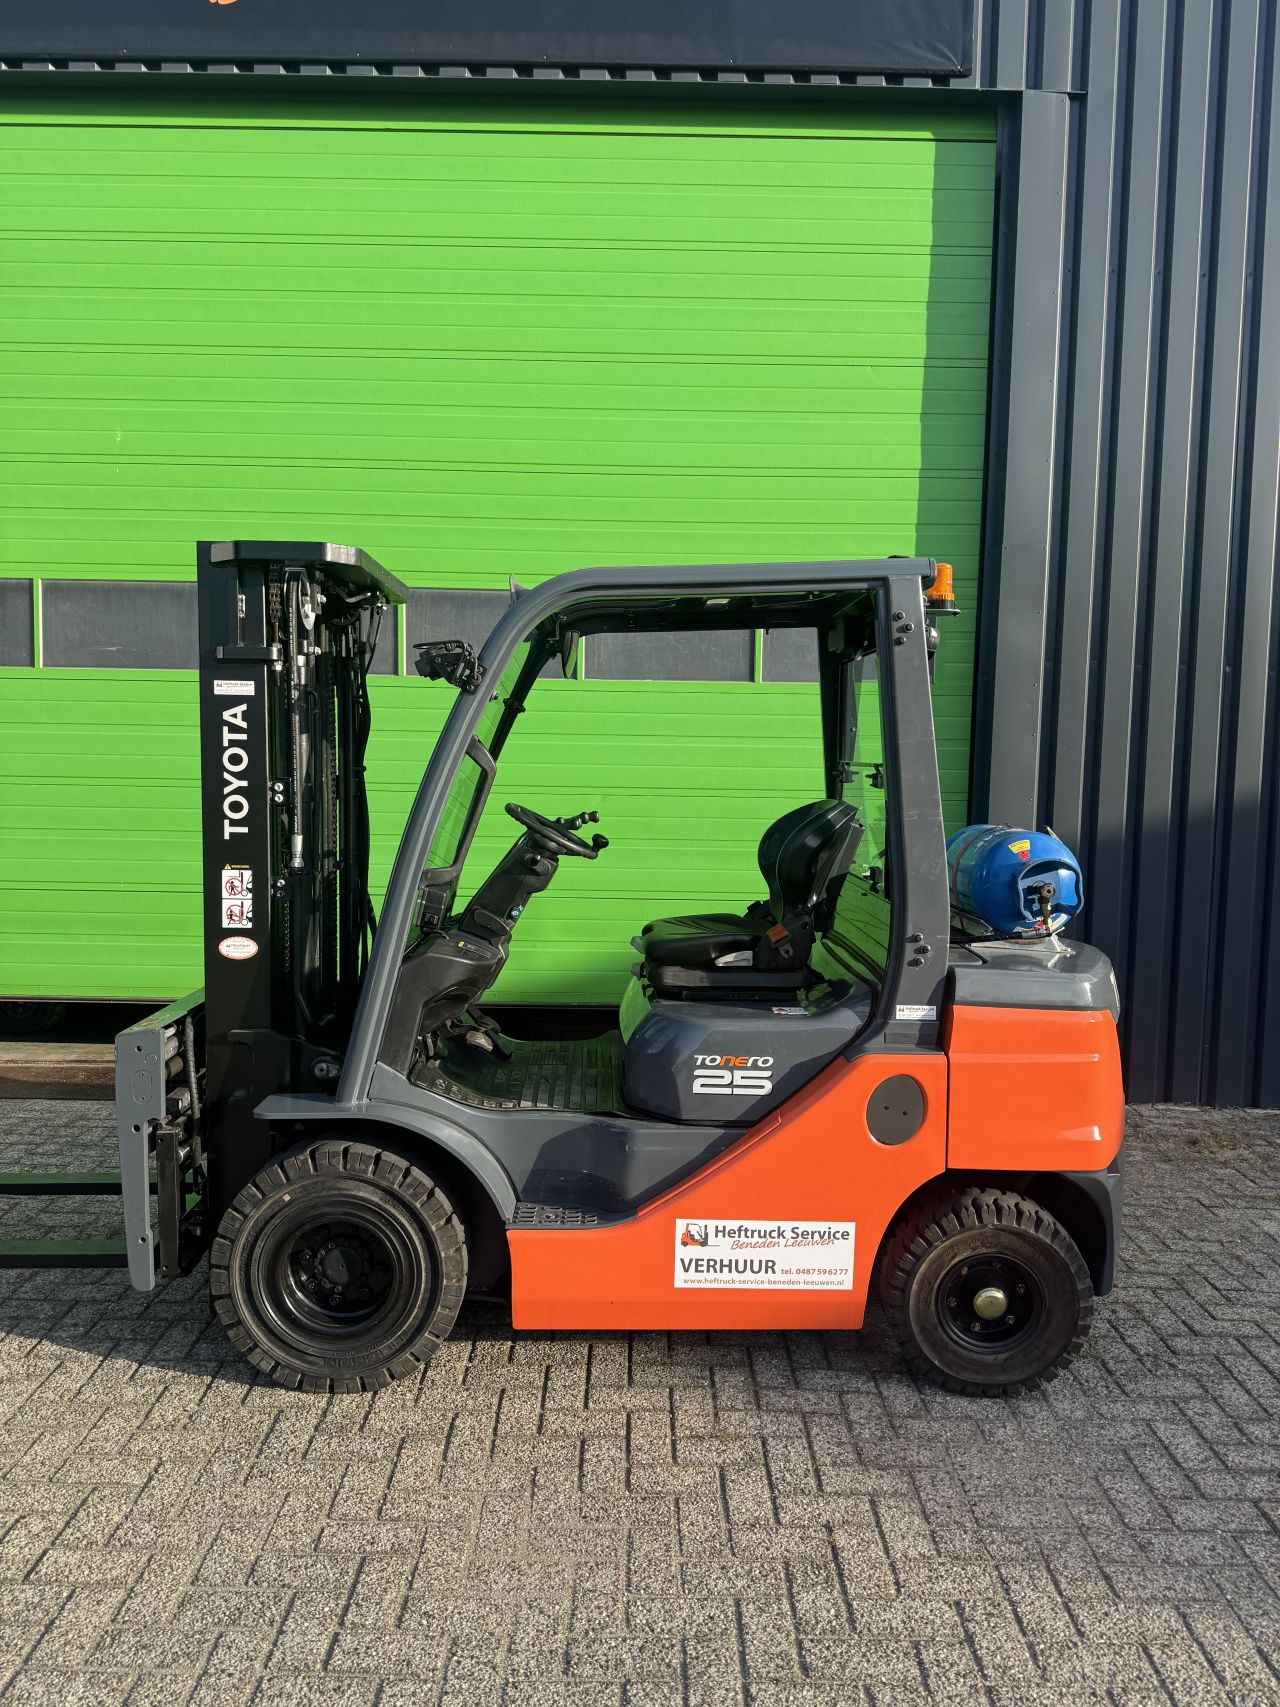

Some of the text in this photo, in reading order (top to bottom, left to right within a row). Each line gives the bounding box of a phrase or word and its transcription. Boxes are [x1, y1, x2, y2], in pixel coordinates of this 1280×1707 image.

[222, 703, 249, 840] TOYOTA
[693, 1069, 773, 1096] 25
[714, 1225, 850, 1241] Heftruck Service
[730, 1237, 835, 1250] Beneden Leeuwen
[680, 1258, 777, 1275] VERHUUR
[683, 1278, 845, 1286] www.heftruck-service-beneden-leeuwen.nl
